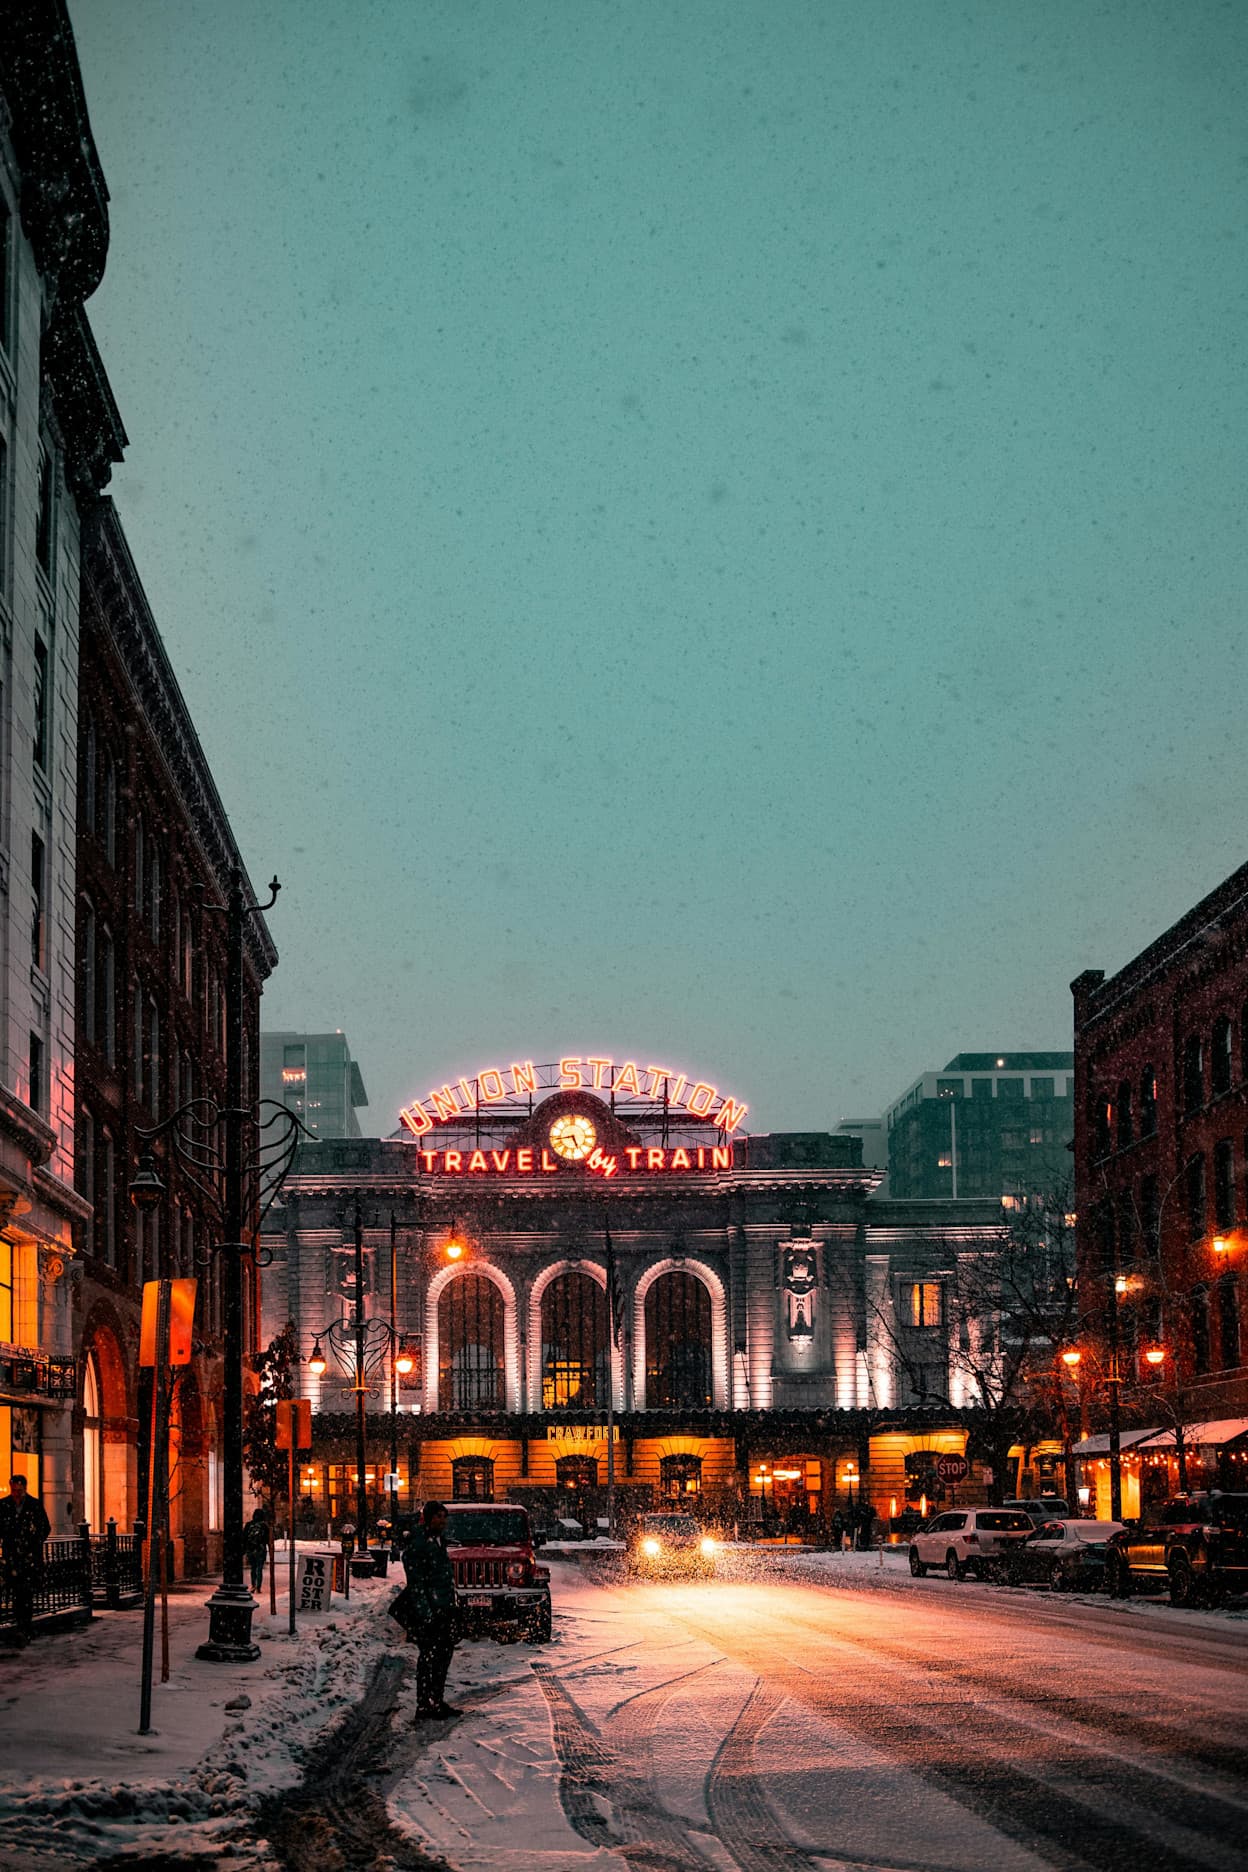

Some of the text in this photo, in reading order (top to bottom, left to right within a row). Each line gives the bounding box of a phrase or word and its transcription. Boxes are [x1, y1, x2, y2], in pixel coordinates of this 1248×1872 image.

[400, 1058, 746, 1135] UNION STATION
[422, 1147, 729, 1177] TRAVEL by TRAIN
[547, 1425, 620, 1443] CRAWFORD
[939, 1462, 966, 1475] STOP
